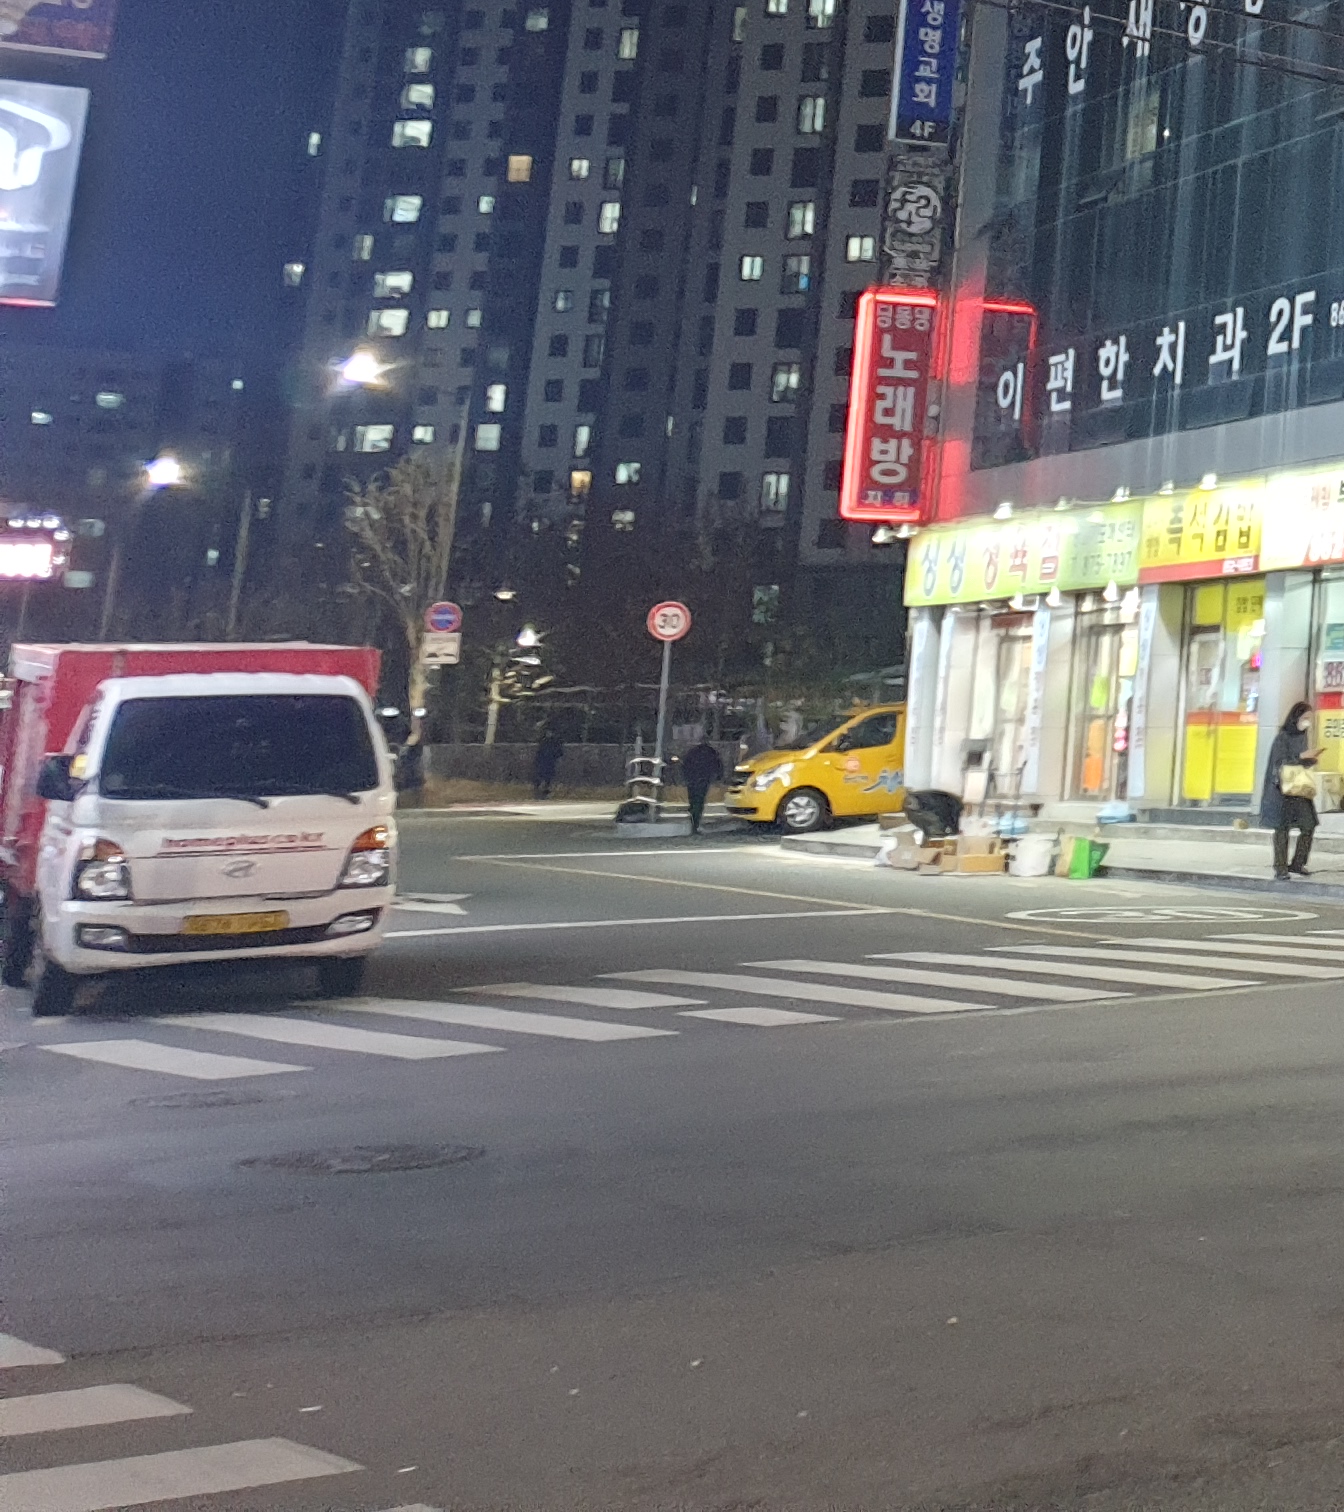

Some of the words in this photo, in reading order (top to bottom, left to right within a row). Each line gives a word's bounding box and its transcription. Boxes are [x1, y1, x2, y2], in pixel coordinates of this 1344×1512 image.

[868, 332, 921, 486] 노래방
[997, 305, 1247, 422] 이편한치과
[1268, 289, 1317, 357] 2F
[657, 612, 681, 630] 30
